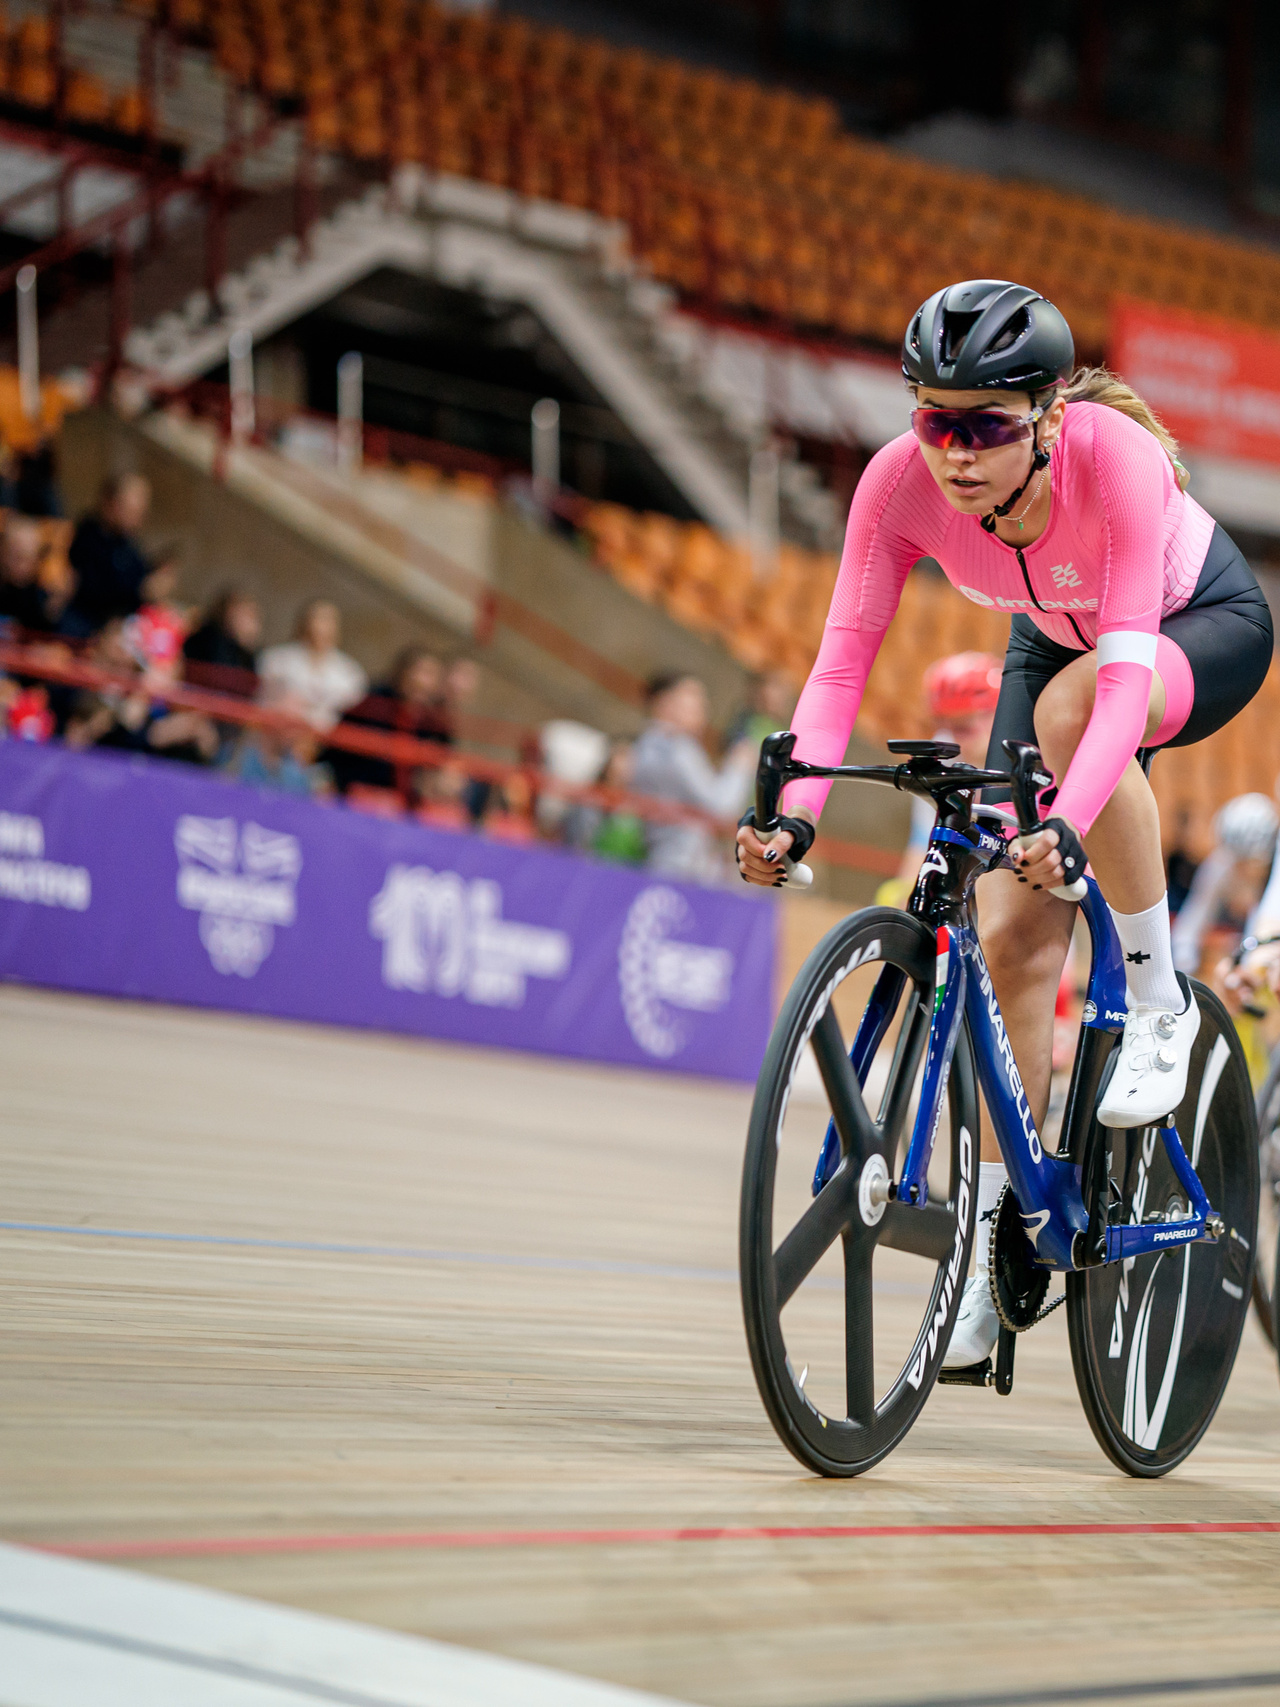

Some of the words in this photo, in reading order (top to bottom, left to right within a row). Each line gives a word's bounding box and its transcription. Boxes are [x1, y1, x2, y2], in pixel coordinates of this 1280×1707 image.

[971, 941, 1043, 1165] PINARELLO
[907, 1125, 972, 1390] CORIMA
[1153, 1228, 1198, 1242] PINARELLO
